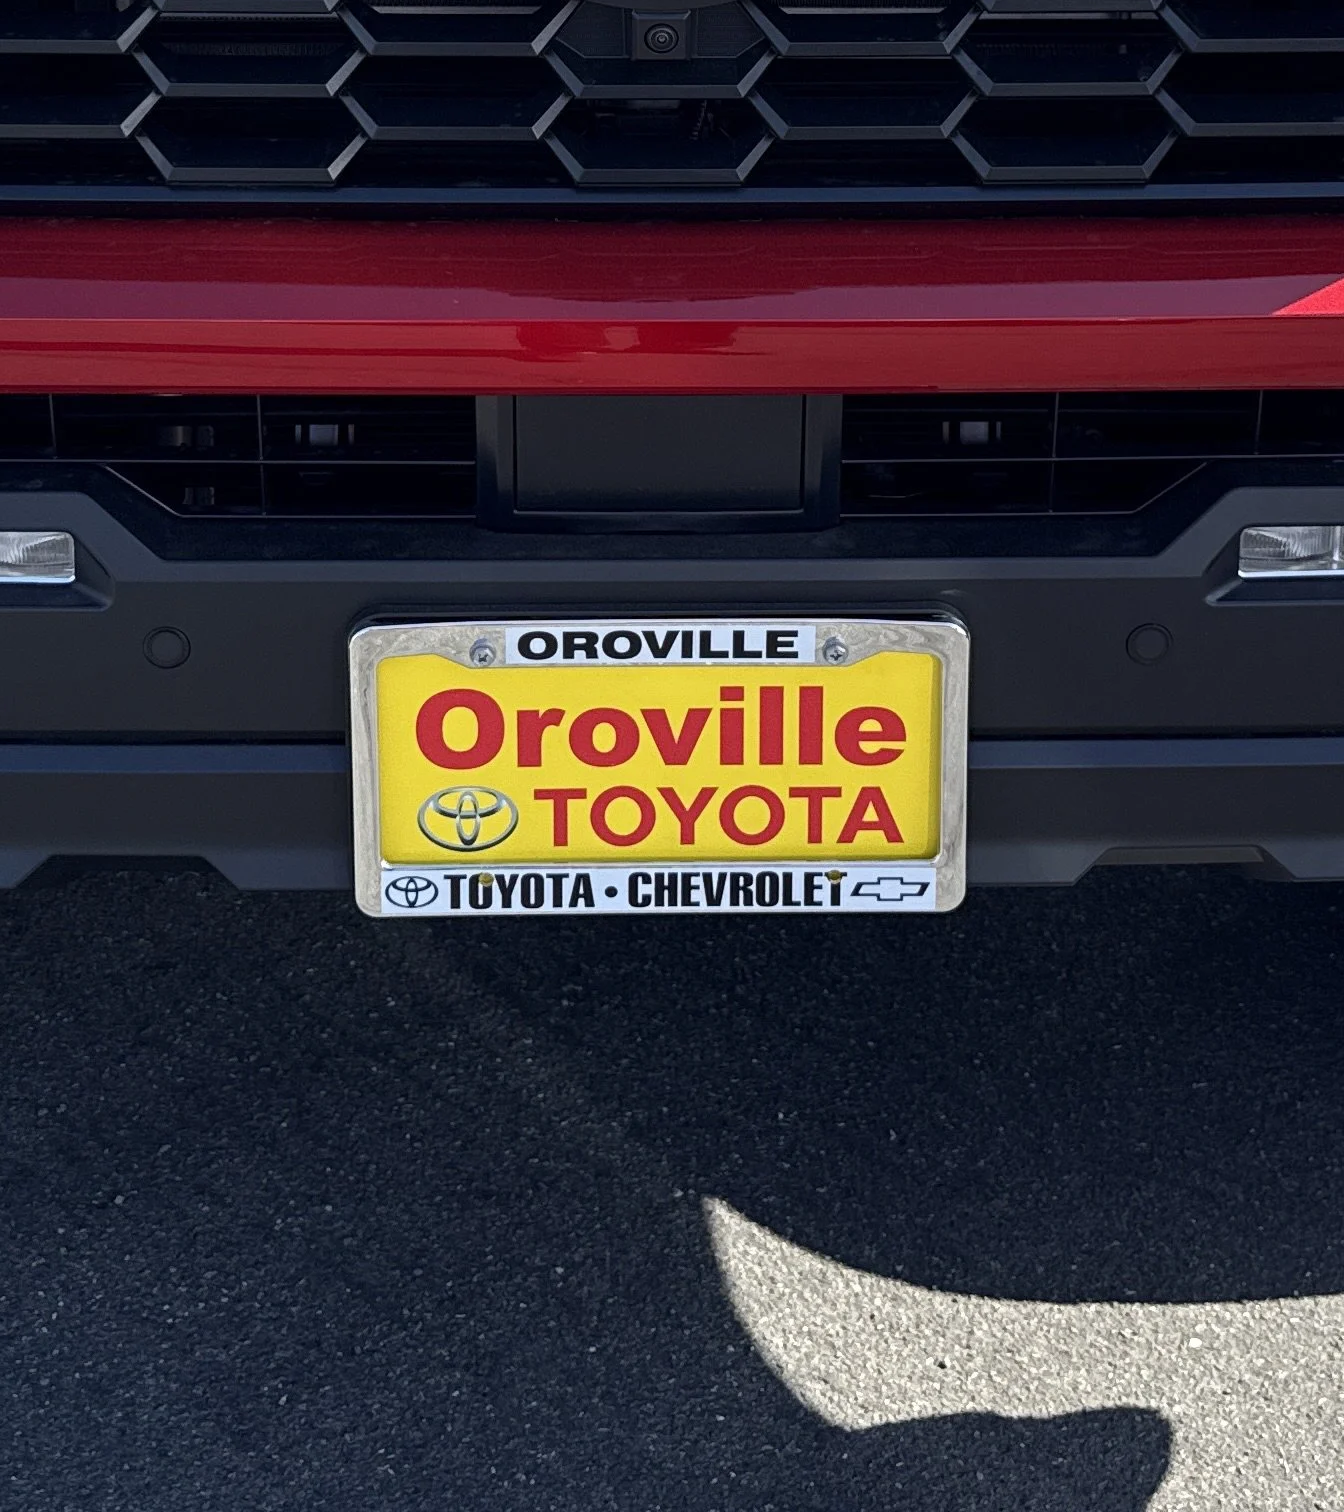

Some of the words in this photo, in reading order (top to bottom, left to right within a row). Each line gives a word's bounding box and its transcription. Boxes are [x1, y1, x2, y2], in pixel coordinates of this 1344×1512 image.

[517, 630, 799, 660] OROVILLE
[416, 686, 907, 770] Oroville
[533, 785, 905, 847] TOYOTA
[444, 873, 592, 909] TOYOTA
[627, 872, 848, 908] CHEVROLET
